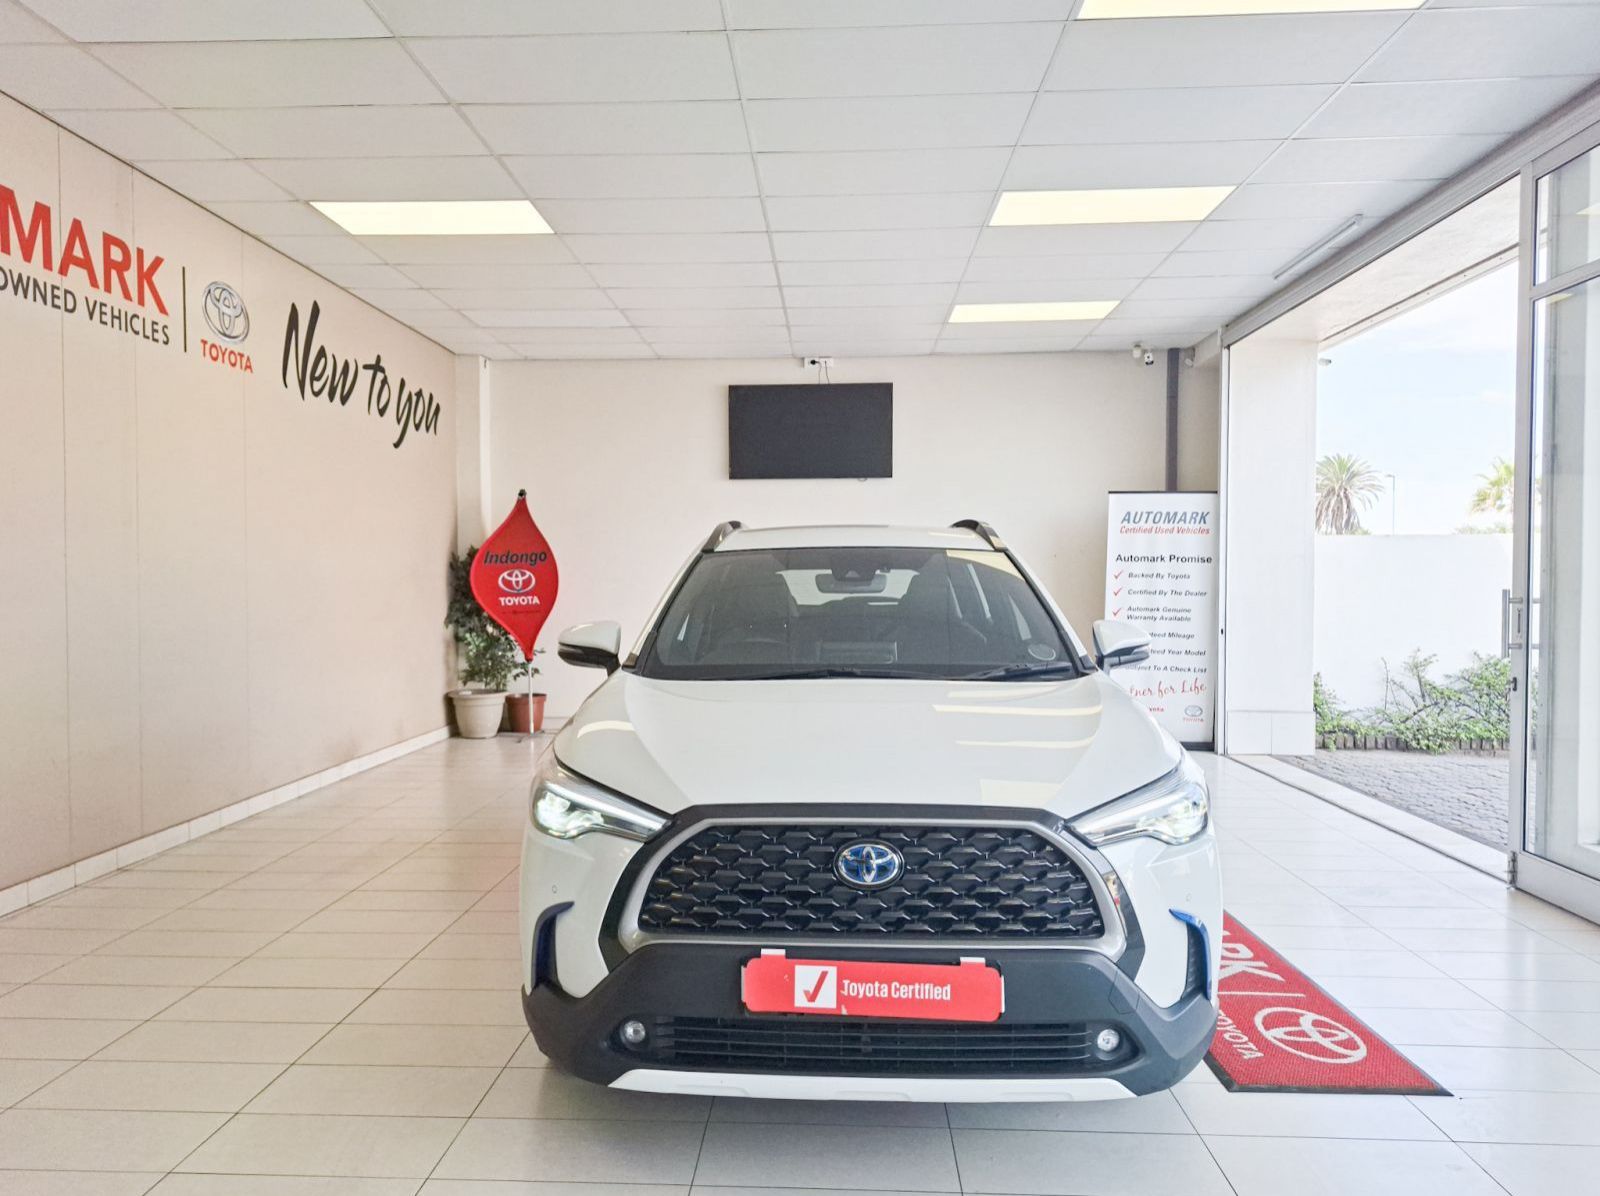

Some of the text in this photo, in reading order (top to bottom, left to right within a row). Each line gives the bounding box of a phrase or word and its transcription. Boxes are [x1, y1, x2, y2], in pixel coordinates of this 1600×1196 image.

[0, 266, 170, 345] OWNED VEHICLES
[200, 339, 253, 373] TOYOTA
[282, 300, 440, 449] New to you
[1121, 511, 1210, 525] AUTOMARK
[1120, 526, 1210, 535] Certified Used Vehicles
[484, 550, 547, 567] Indongo
[1116, 554, 1213, 564] Automark Promise
[1158, 589, 1168, 597] By
[498, 595, 540, 607] TOYOTA
[1126, 614, 1157, 622] Warranty
[1168, 632, 1195, 640] Mileage
[1157, 680, 1177, 699] for
[842, 980, 951, 1001] Toyota Certified
